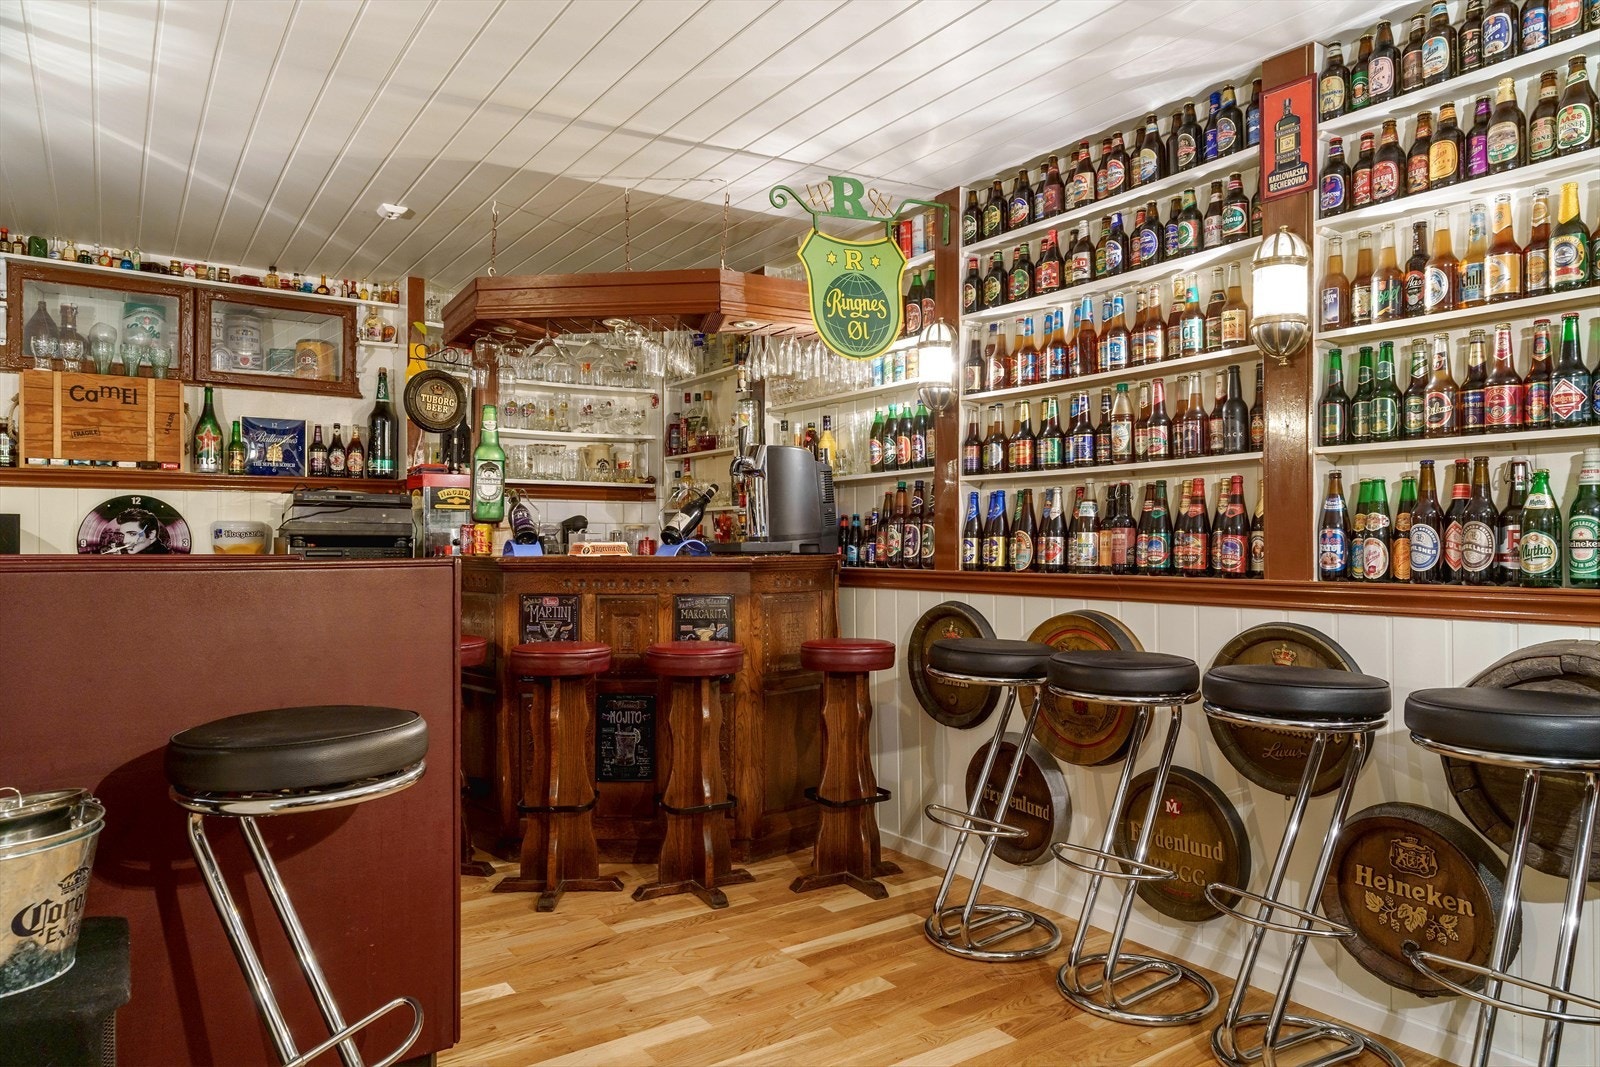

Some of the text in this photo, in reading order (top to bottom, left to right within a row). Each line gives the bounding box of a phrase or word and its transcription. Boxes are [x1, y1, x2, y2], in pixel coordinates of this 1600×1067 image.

[1269, 174, 1307, 192] BECHEROVKA
[828, 175, 868, 217] R
[844, 249, 864, 271] R
[826, 288, 887, 319] Ringnes
[300, 356, 312, 364] CB
[421, 393, 455, 408] TUBORG
[425, 403, 449, 414] BEER
[73, 428, 98, 438] FRAGILE
[131, 497, 141, 505] 12
[440, 489, 471, 498] NACHO
[80, 539, 87, 548] 9
[182, 538, 189, 547] 3
[1521, 544, 1553, 561] Mythos
[530, 605, 572, 623] MARTINI
[680, 608, 728, 619] MARGARITA
[609, 711, 642, 724] MOJITO
[983, 784, 1050, 821] Fryenlund
[1130, 820, 1223, 862] Fdenlund
[1354, 864, 1475, 918] Heineken
